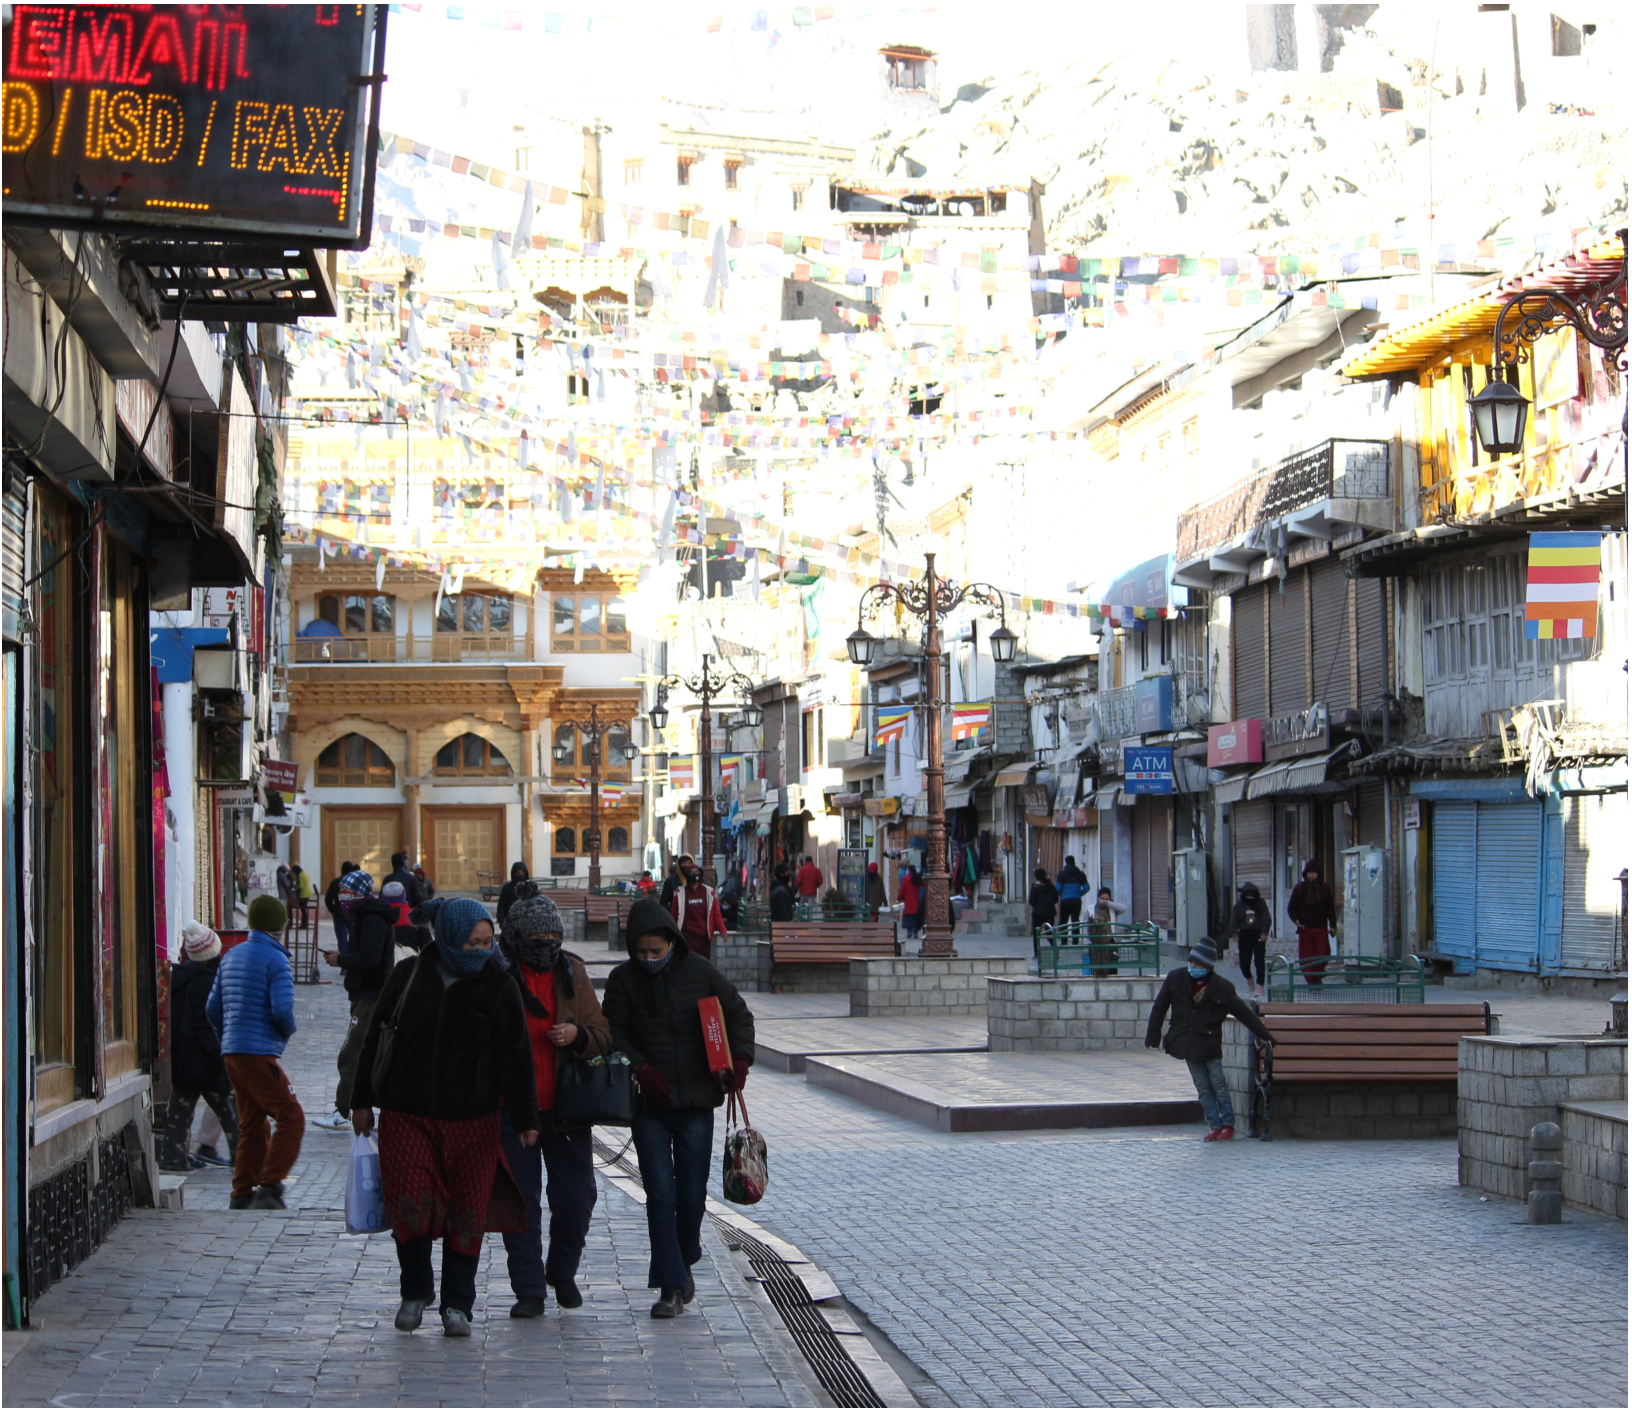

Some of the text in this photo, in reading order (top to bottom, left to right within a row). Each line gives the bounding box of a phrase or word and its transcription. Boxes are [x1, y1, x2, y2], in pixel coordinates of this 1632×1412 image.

[84, 88, 185, 164] ISD
[229, 100, 345, 178] FAX
[1132, 756, 1167, 770] ATM
